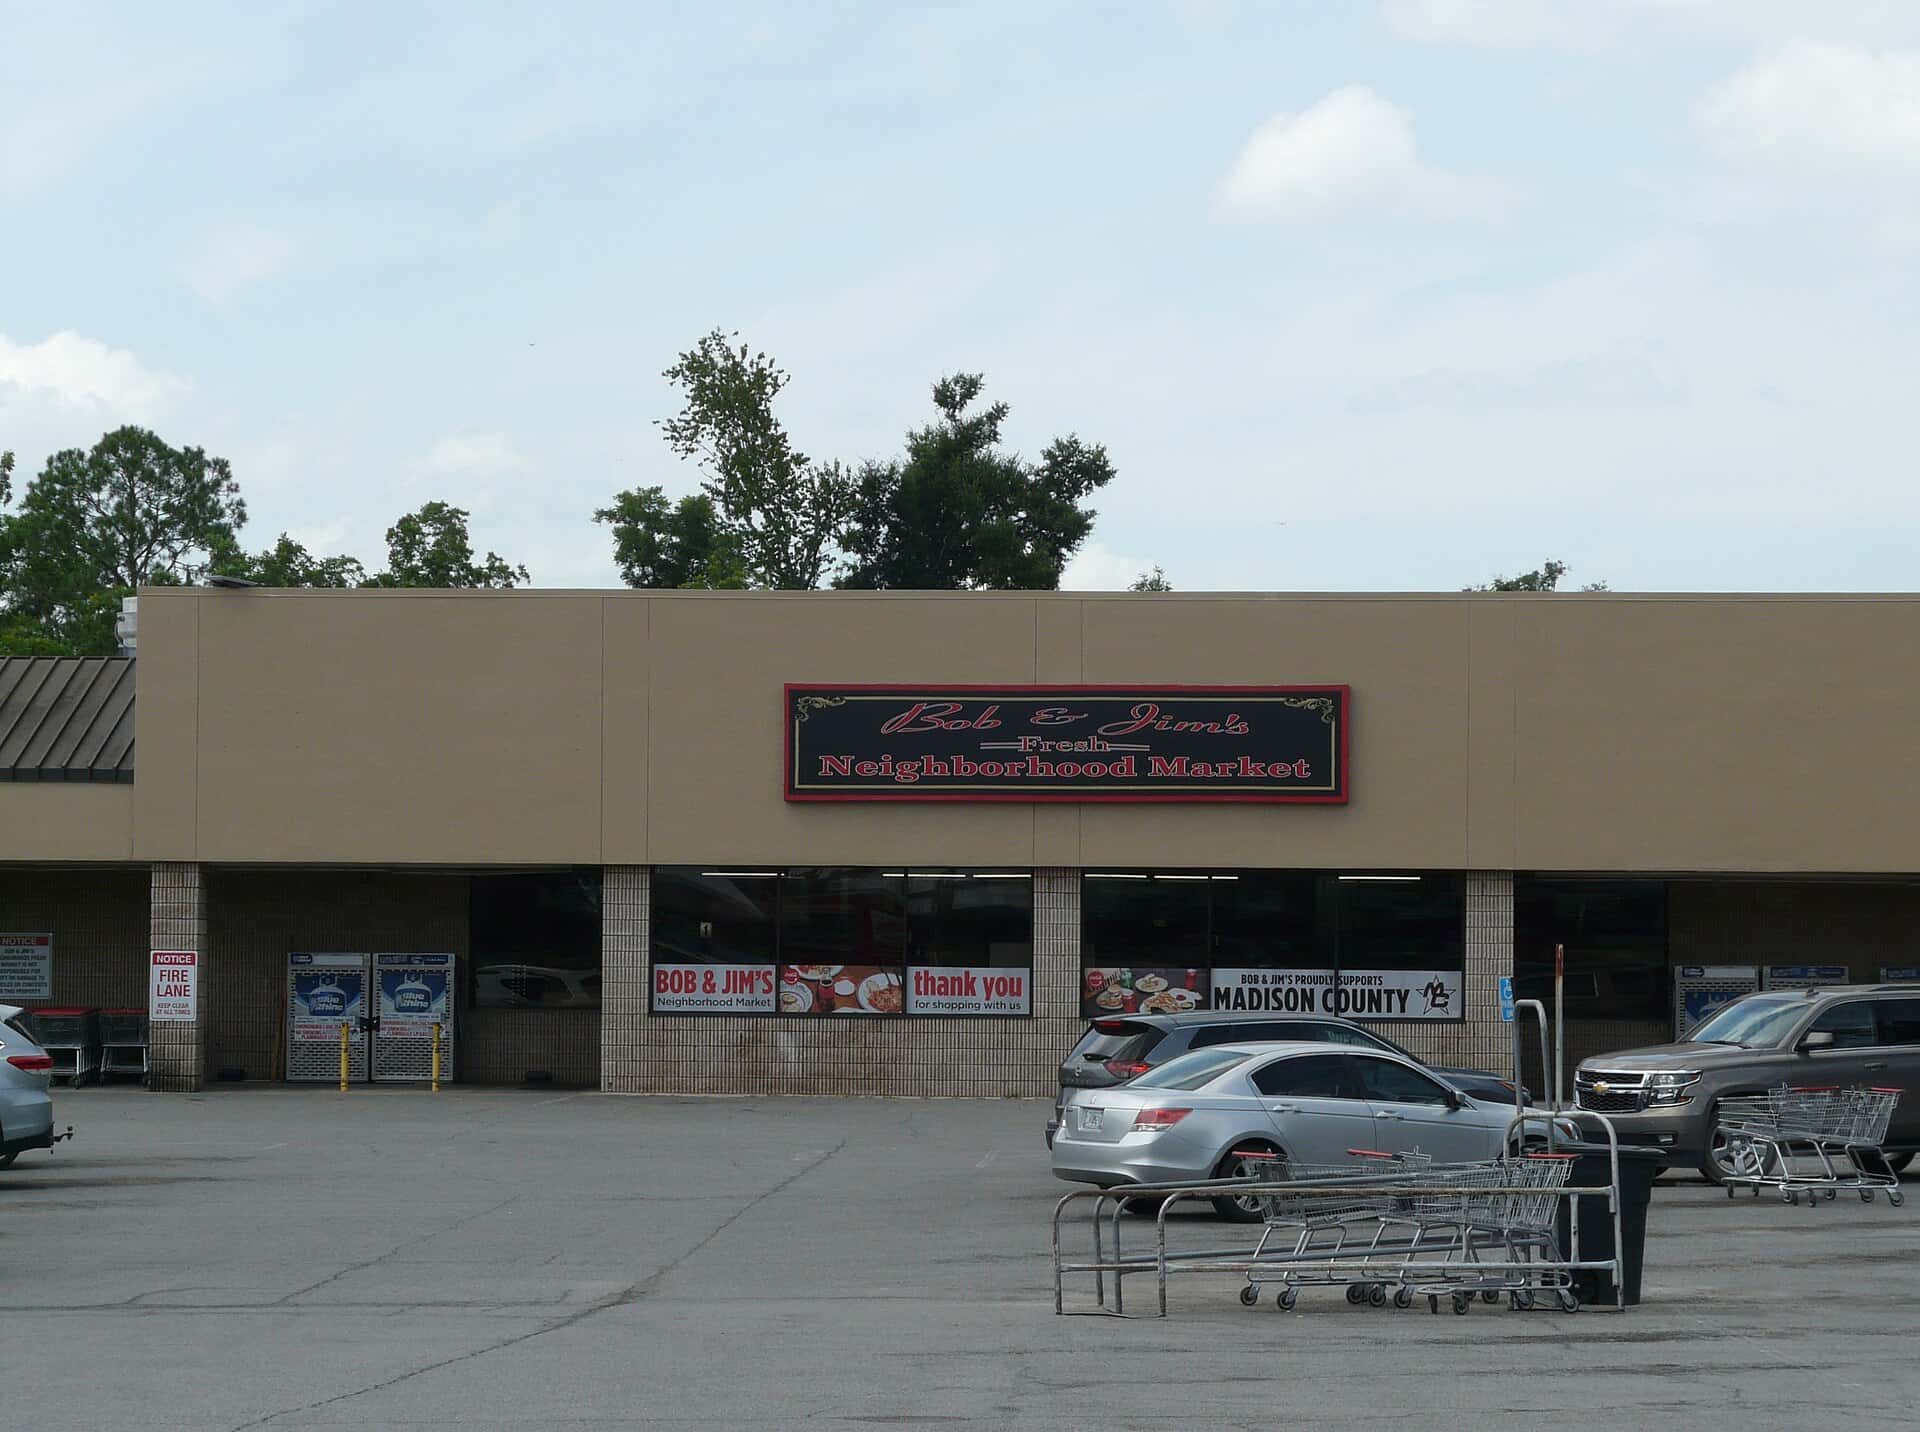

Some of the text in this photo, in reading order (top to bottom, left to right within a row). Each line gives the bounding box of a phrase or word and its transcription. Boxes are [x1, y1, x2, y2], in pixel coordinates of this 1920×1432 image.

[880, 703, 1250, 736] Bob & Jim's
[1017, 735, 1112, 752] Fresh
[818, 754, 1312, 783] Neighborhood Market
[156, 954, 193, 964] NOTICE
[159, 969, 189, 982] FIRE
[656, 969, 697, 994] BOB
[702, 969, 717, 994] &
[721, 969, 773, 995] JIM'S
[1241, 974, 1384, 986] BOB & JIM'S PROUDLY SUPPORTS
[156, 984, 191, 997] LANE
[914, 970, 1022, 1001] thank you
[657, 997, 771, 1008] Neighborhood Market
[915, 1000, 1022, 1011] for shopping with us
[1214, 987, 1410, 1014] MADISON COUNTY
